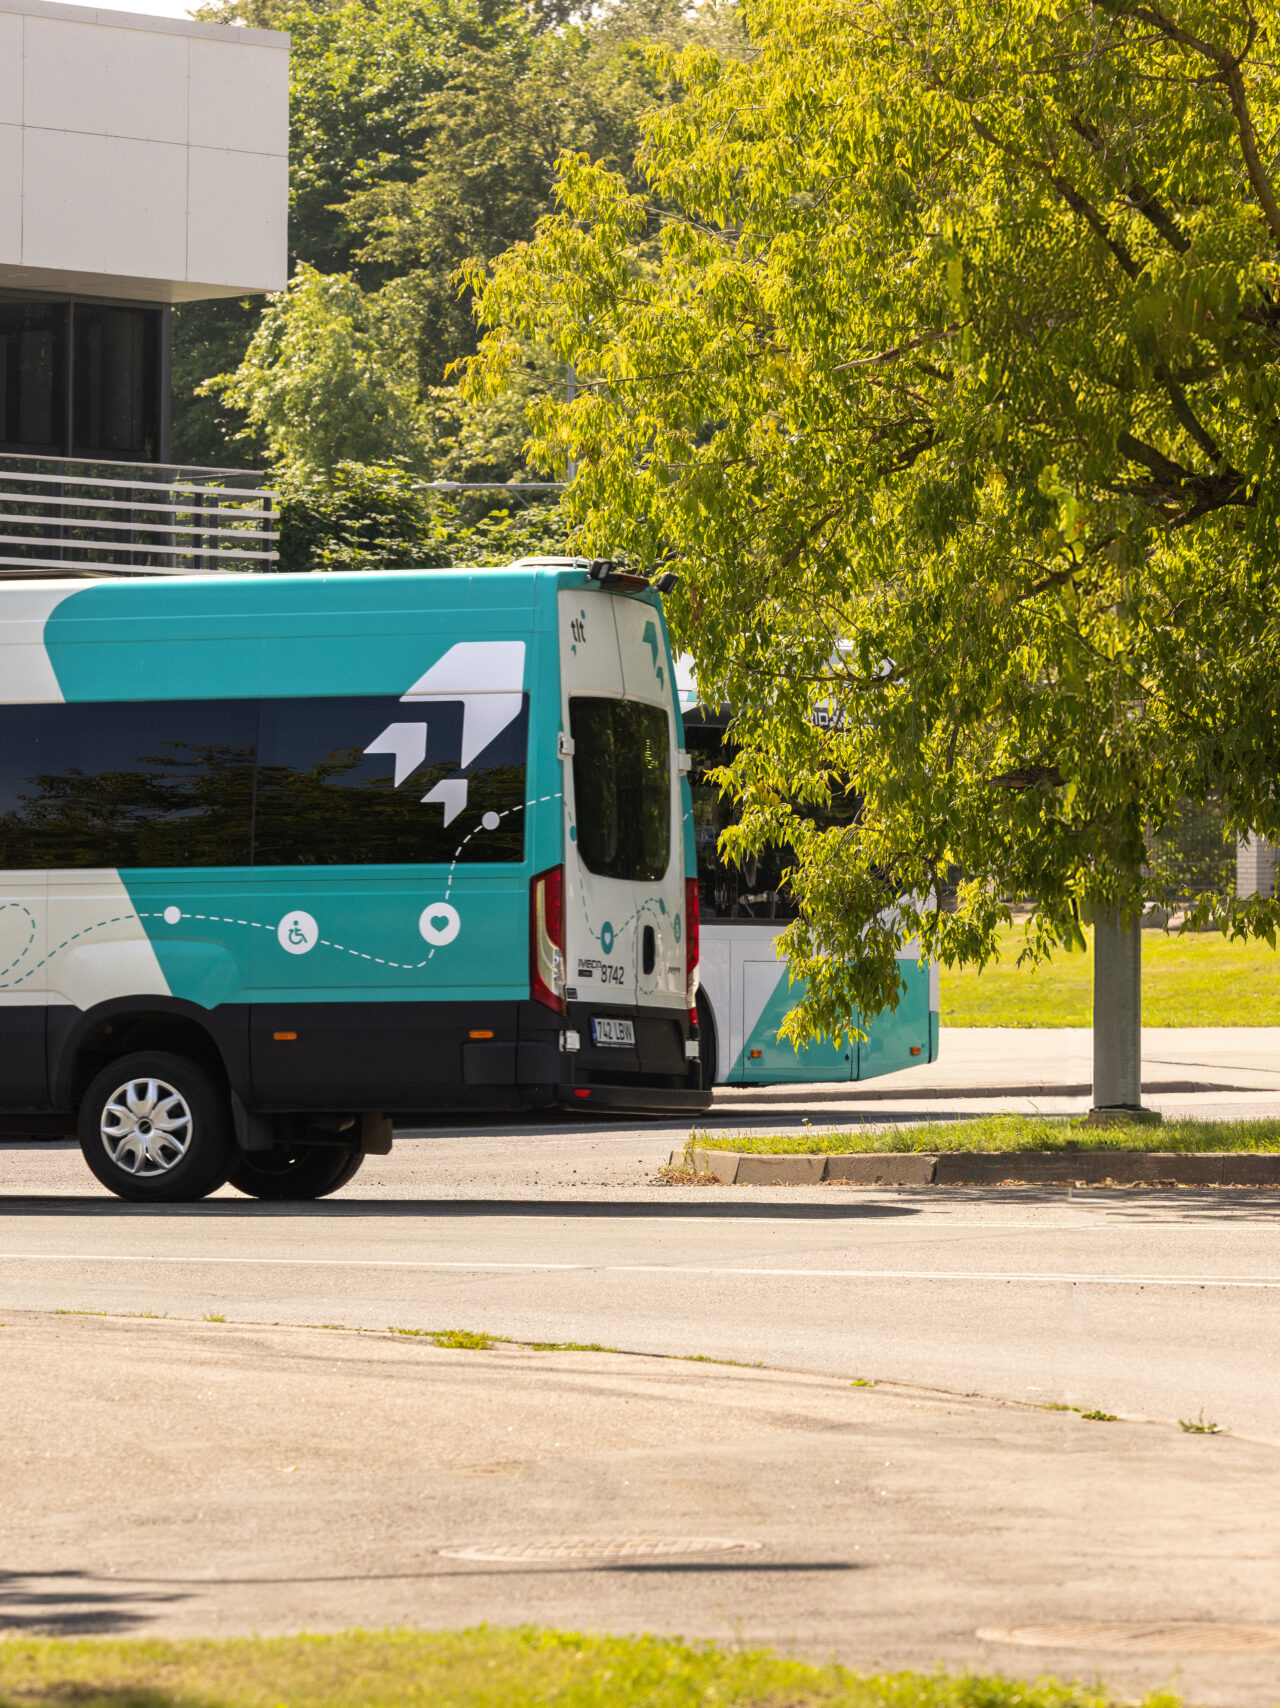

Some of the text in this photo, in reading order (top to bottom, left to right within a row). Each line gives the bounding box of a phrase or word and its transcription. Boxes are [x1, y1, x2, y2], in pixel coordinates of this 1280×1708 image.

[570, 618, 586, 643] tlt
[578, 958, 602, 969] IVECO
[601, 964, 624, 985] 8742
[597, 1021, 633, 1042] 742 LBW
